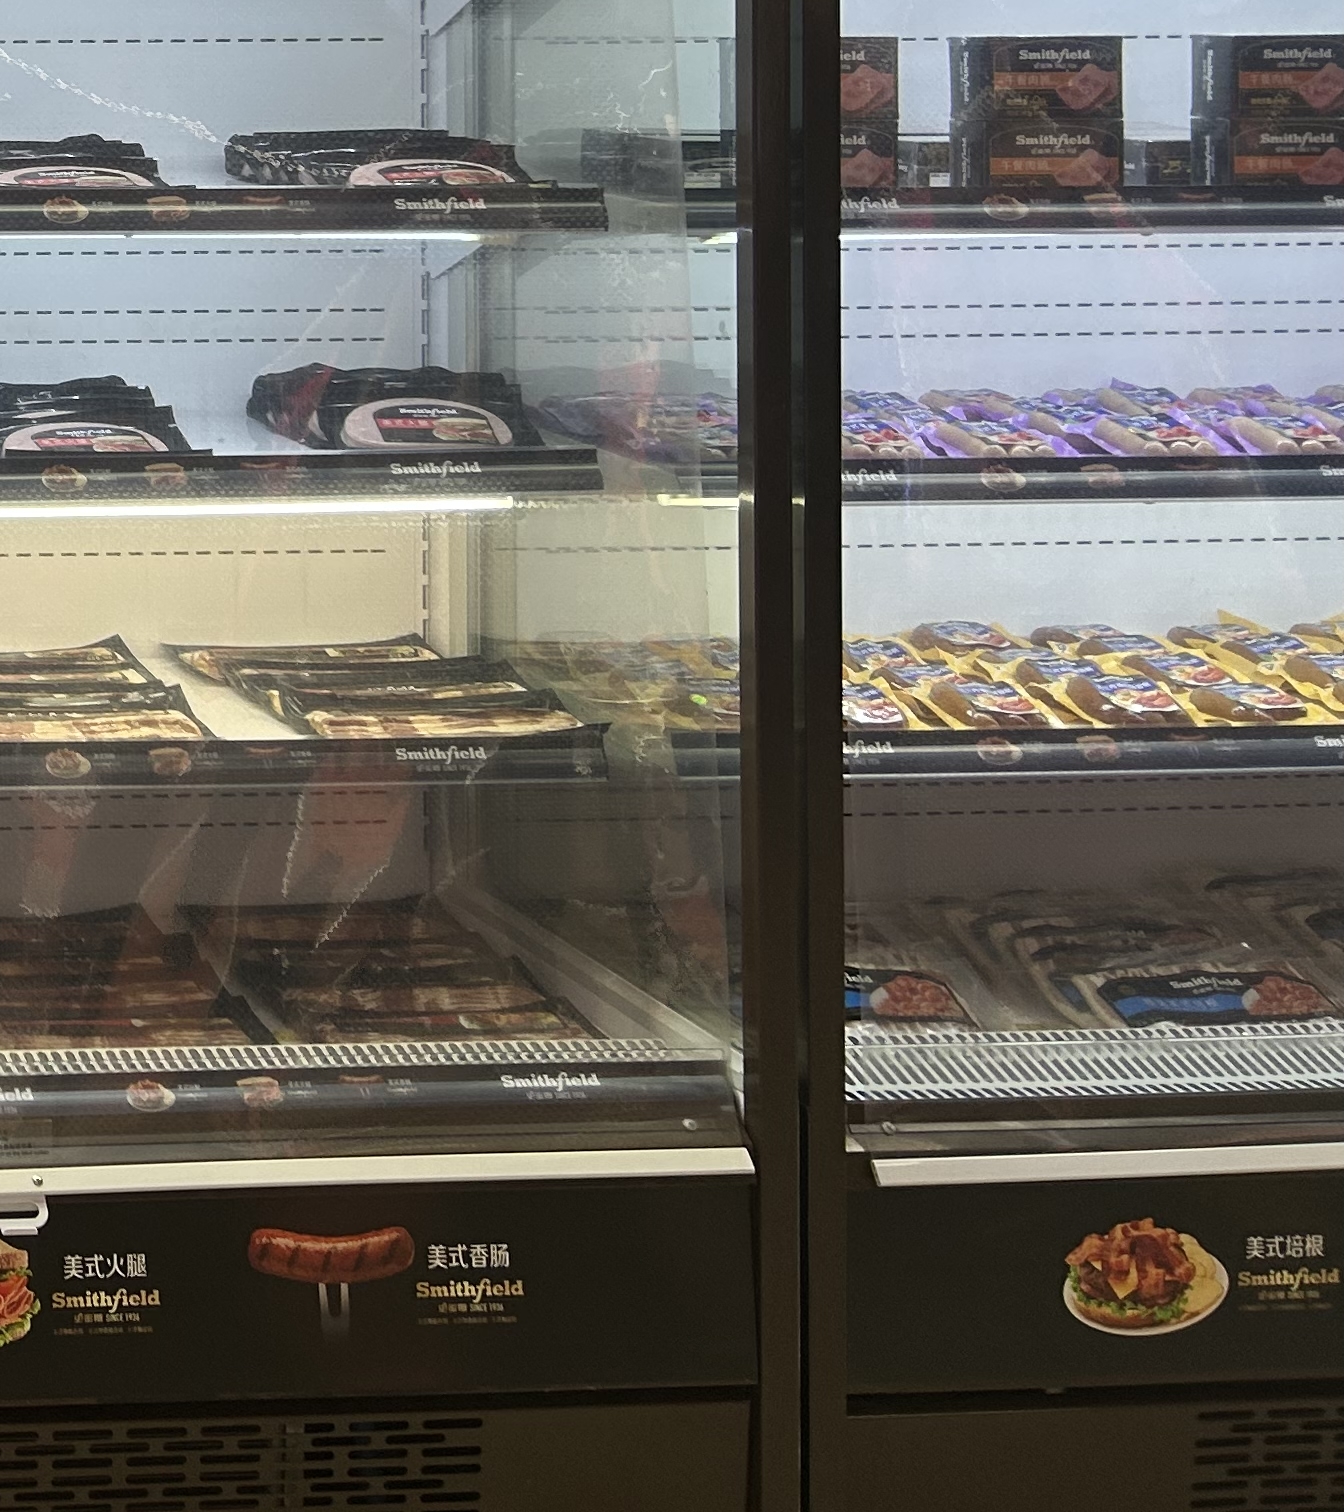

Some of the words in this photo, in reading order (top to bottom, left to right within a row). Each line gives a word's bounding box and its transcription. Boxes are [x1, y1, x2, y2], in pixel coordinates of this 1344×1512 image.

[1019, 49, 1090, 63] Smithfield
[1263, 48, 1333, 62] Smithfield
[1015, 134, 1090, 148] Smithfield
[1260, 132, 1334, 146] Smithfield
[394, 197, 487, 214] Smithfield
[390, 460, 482, 478] Smithfield
[396, 746, 487, 764] Smithfield
[500, 1072, 601, 1091] Smithfield
[427, 1243, 510, 1270] 美式香肠
[63, 1253, 148, 1280] 美式火腿
[1237, 1266, 1341, 1291] Smithfield
[416, 1278, 525, 1303] Smithfield
[52, 1288, 161, 1313] Smithfield
